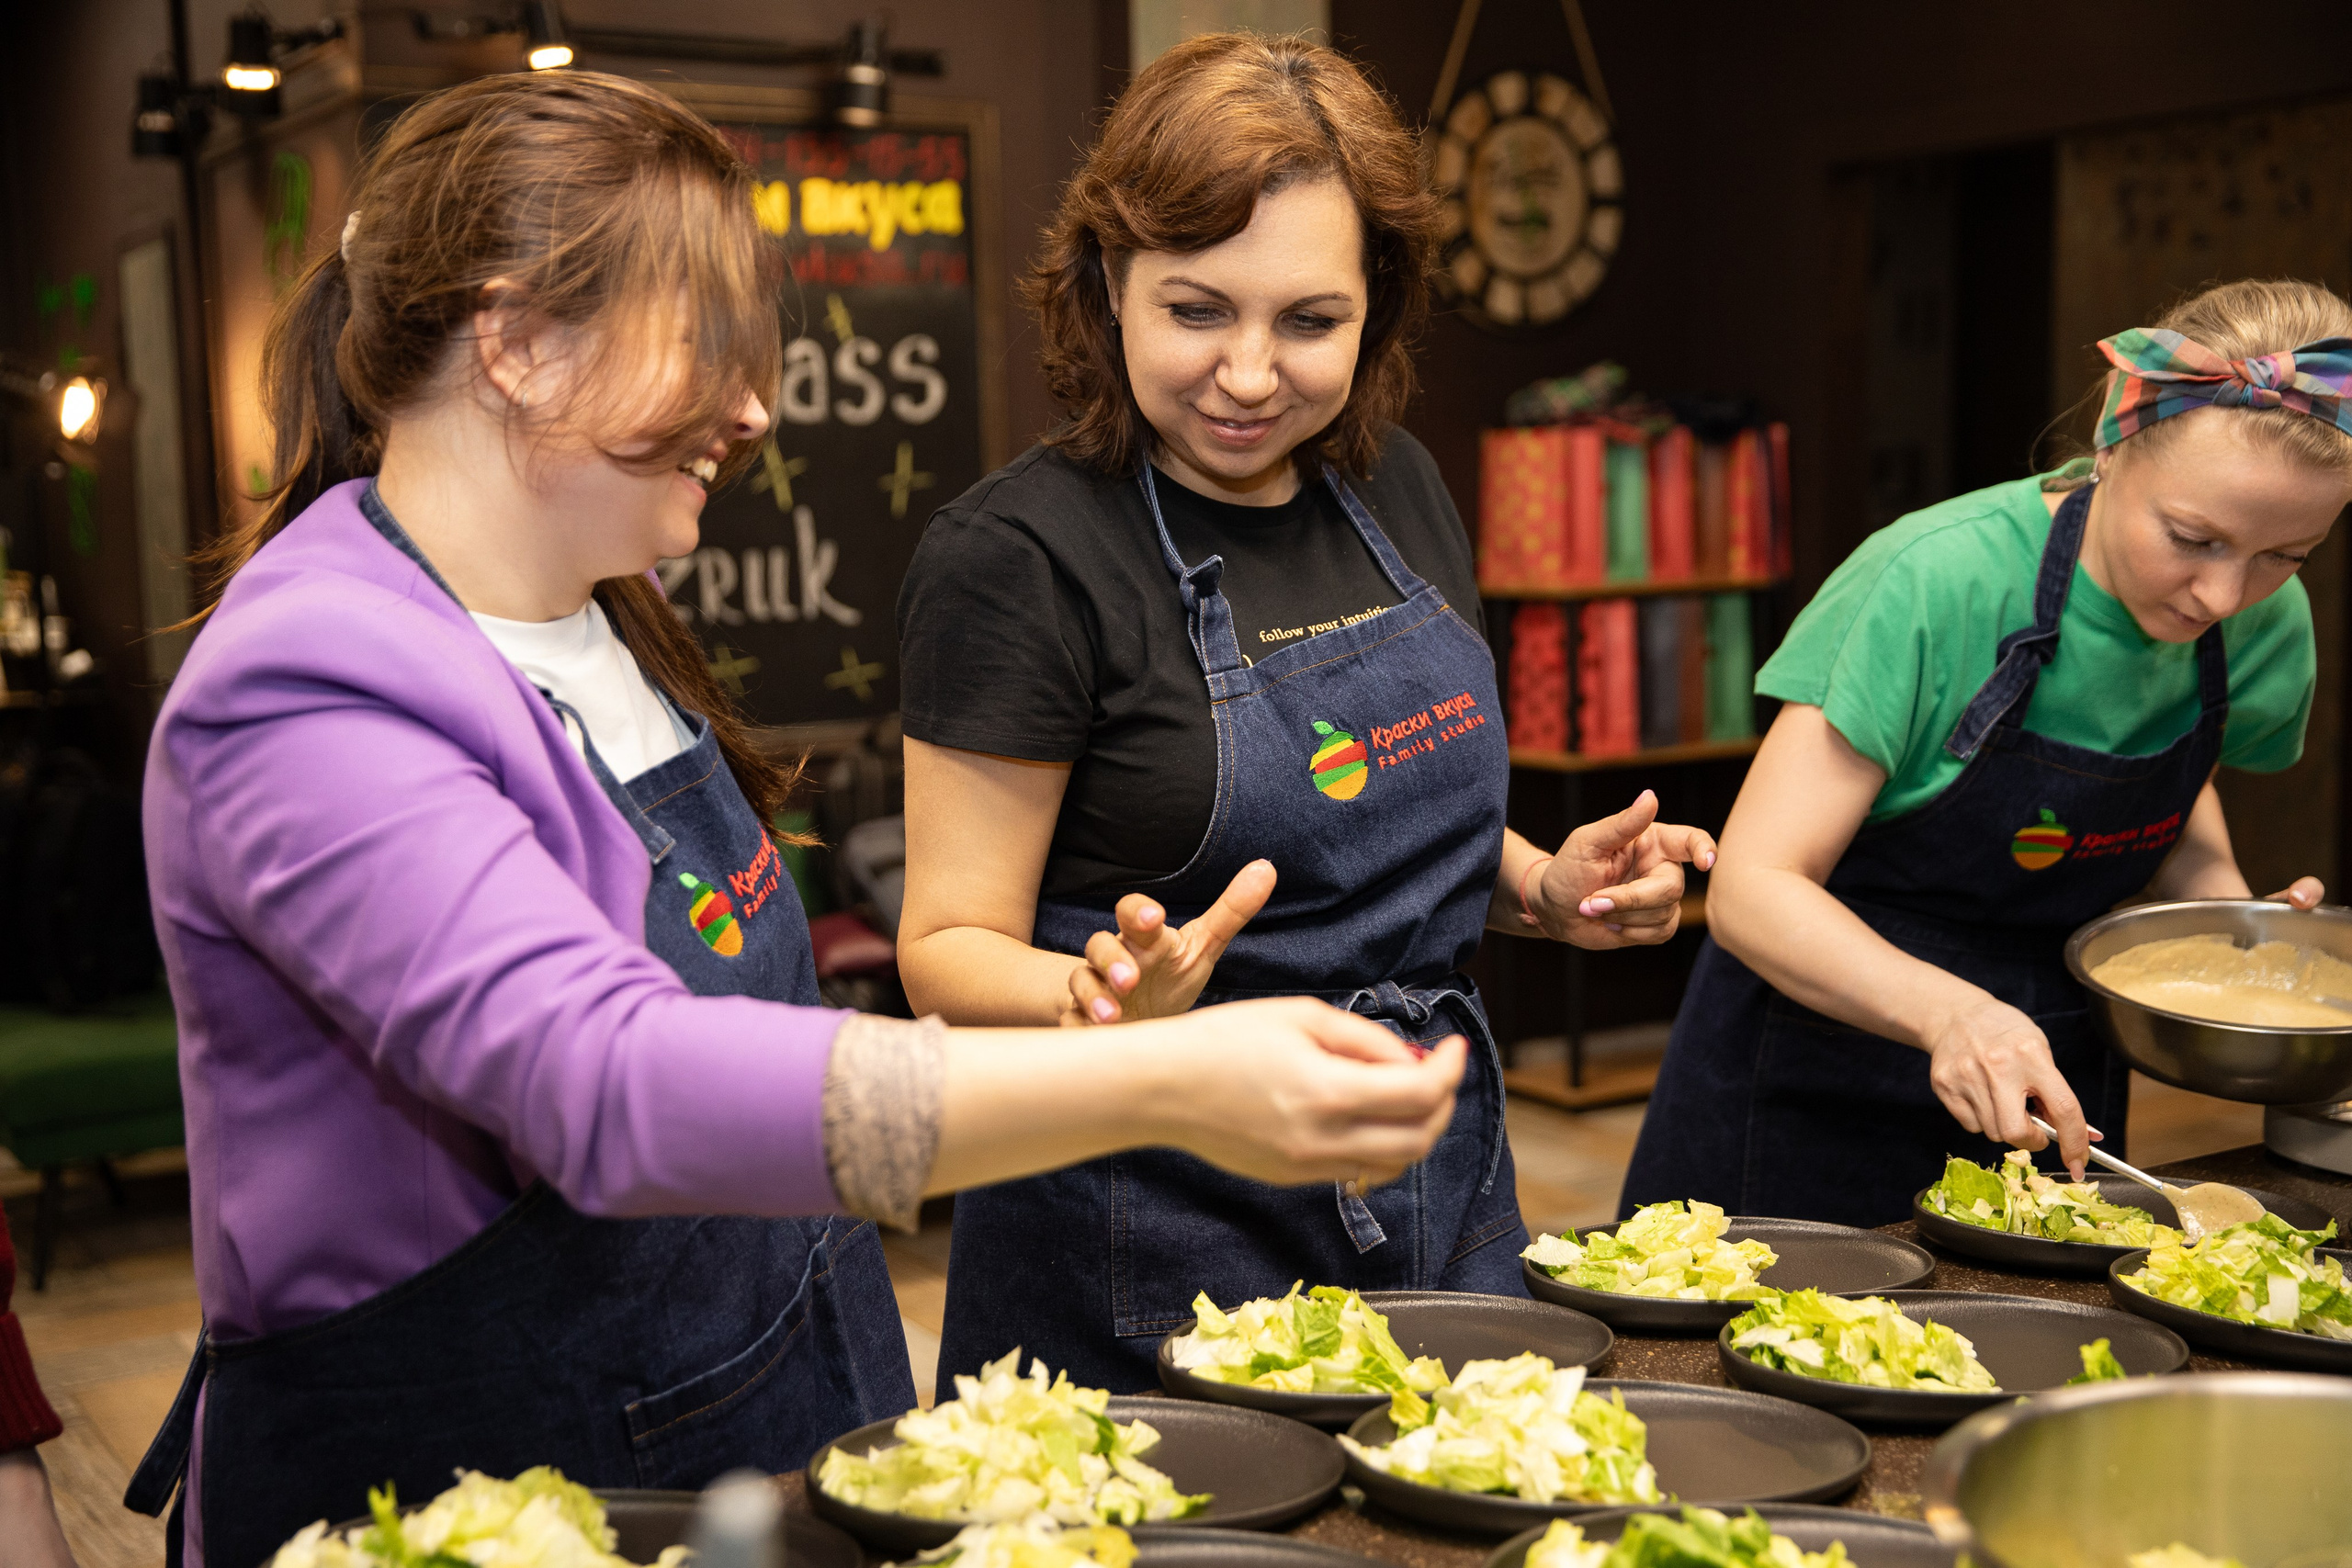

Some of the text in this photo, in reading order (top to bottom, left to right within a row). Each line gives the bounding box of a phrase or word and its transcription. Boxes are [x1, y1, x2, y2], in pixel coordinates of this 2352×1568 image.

[781, 334, 948, 426] ass
[1260, 627, 1304, 643] follow
[1306, 620, 1340, 637] your
[1370, 711, 1433, 750] Краски
[1377, 714, 1486, 770] Family studio
